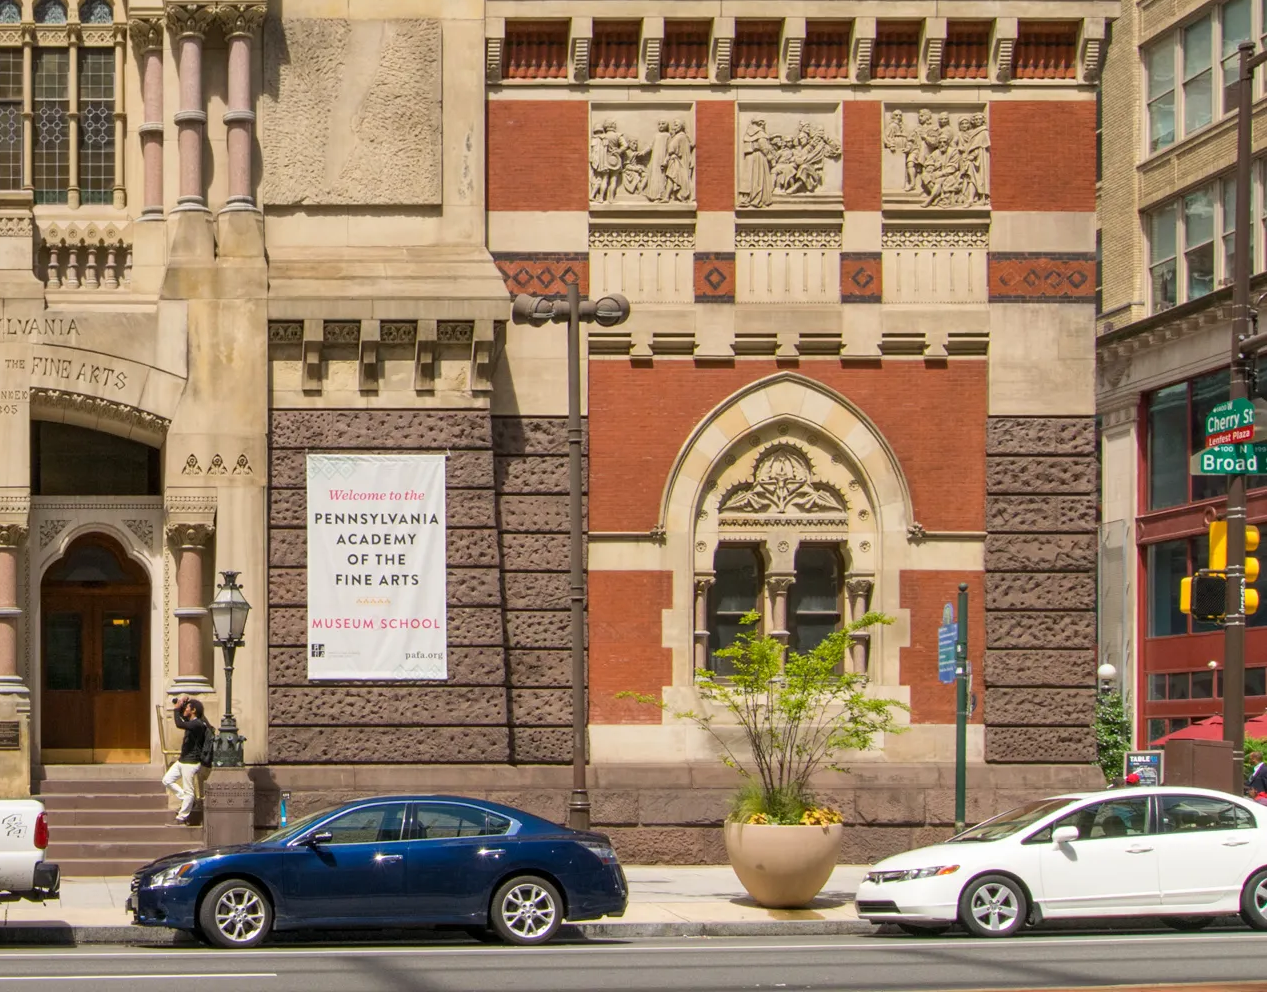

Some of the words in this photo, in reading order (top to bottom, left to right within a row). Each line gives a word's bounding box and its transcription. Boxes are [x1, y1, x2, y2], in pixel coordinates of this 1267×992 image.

[5, 360, 26, 369] THE
[31, 356, 72, 379] FINE
[76, 363, 127, 390] ARTS
[1208, 413, 1240, 433] Cherry
[1243, 408, 1254, 424] St
[1209, 433, 1231, 446] Lenfest
[1233, 429, 1250, 441] Plaza
[1239, 444, 1248, 454] N
[1203, 454, 1258, 471] Broad
[329, 489, 386, 501] Welcome
[389, 490, 402, 501] to
[404, 489, 425, 501] the
[314, 513, 439, 525] PENNSYLVANIA
[336, 533, 417, 545] ACADEMY
[347, 553, 369, 565] OF
[375, 554, 406, 565] THE
[335, 574, 373, 586] FINE
[378, 574, 419, 586] ARTS
[312, 618, 374, 629] MUSEUM
[380, 618, 441, 629] SCHOOL
[405, 651, 444, 660] pafa.org
